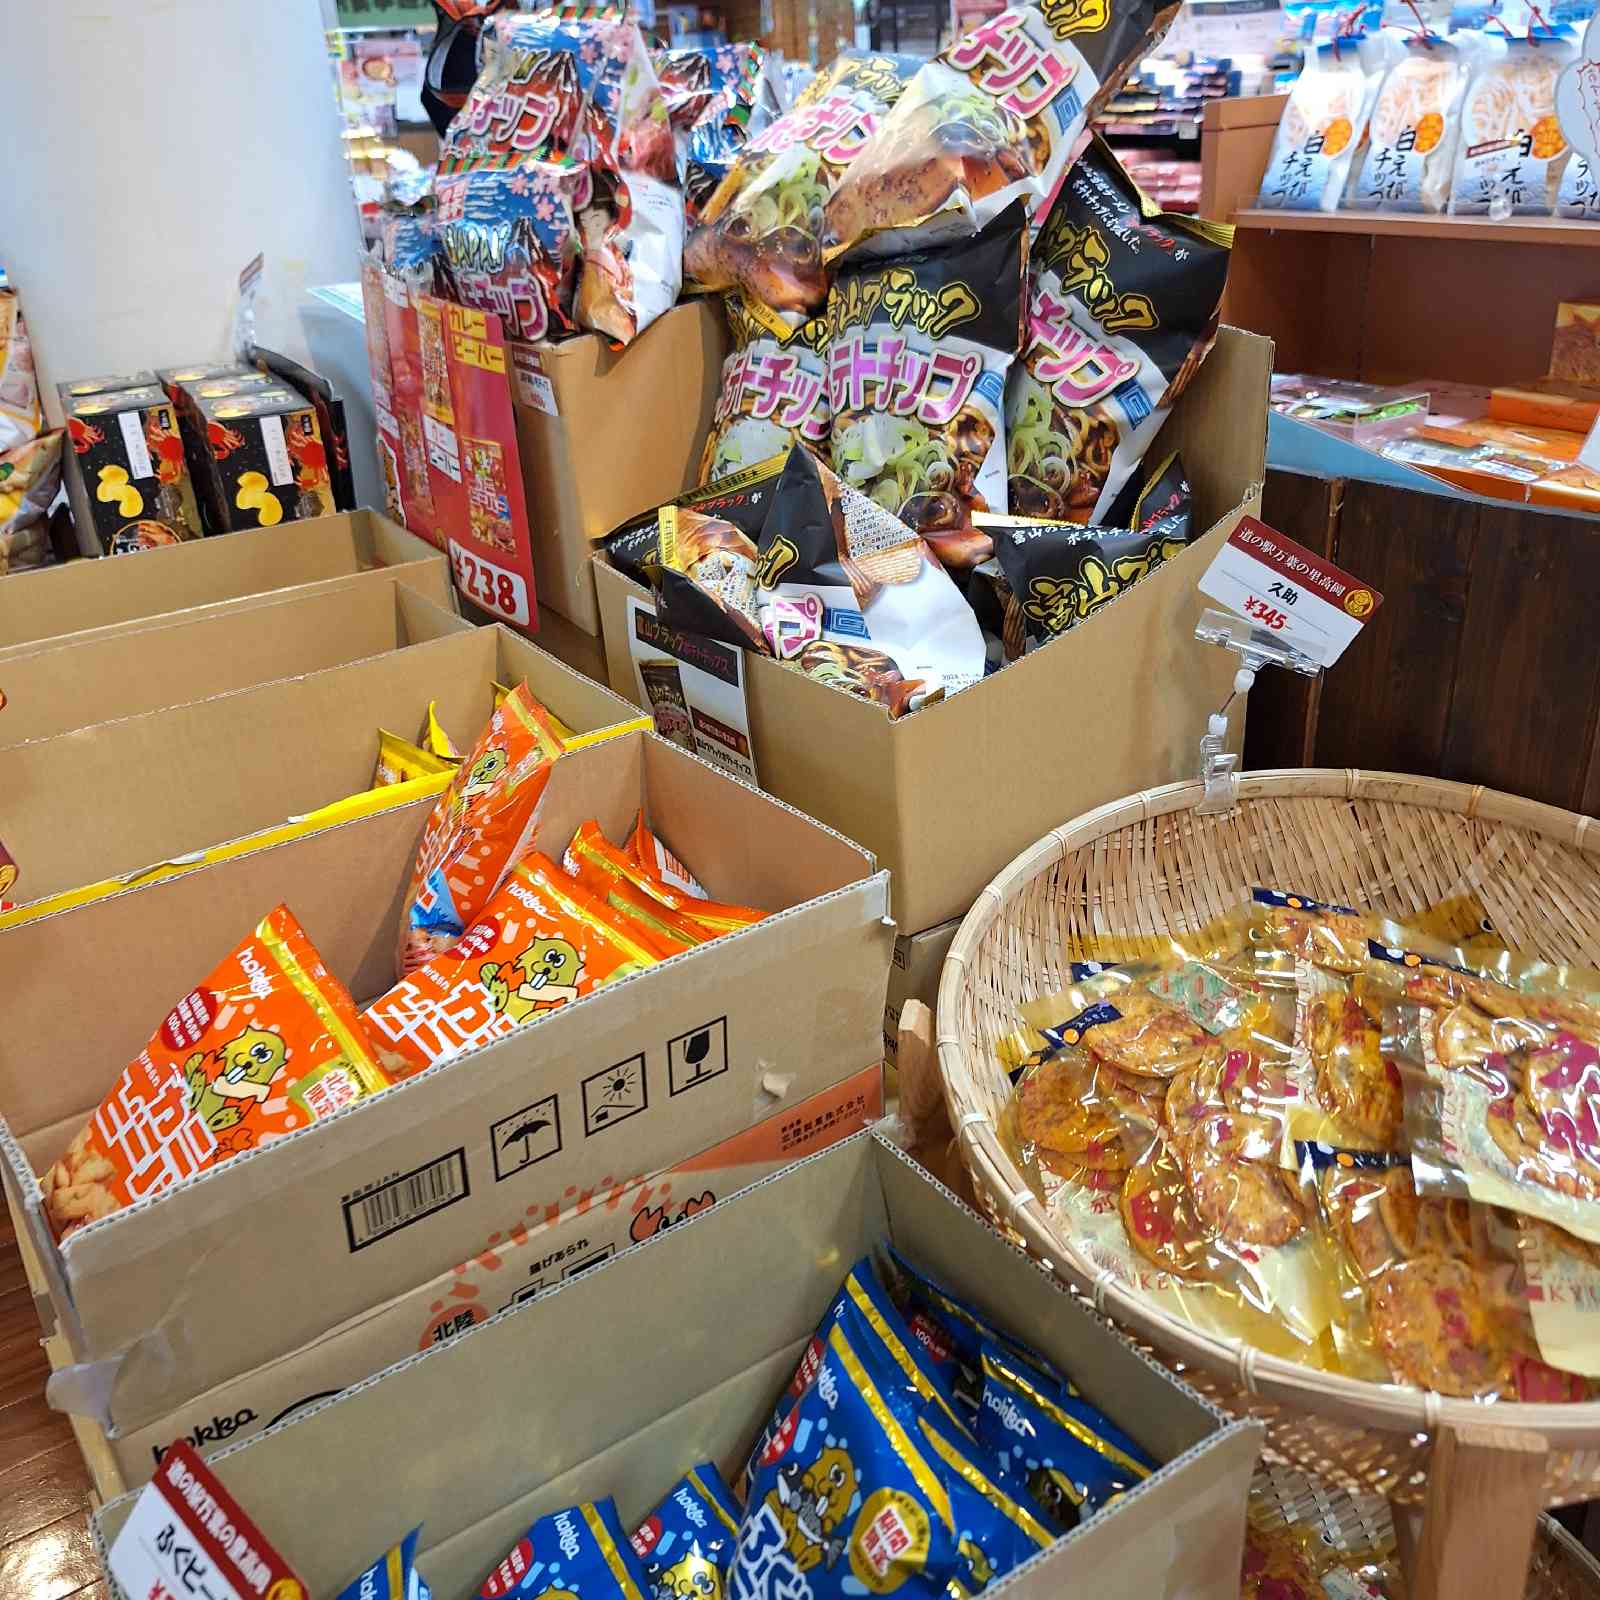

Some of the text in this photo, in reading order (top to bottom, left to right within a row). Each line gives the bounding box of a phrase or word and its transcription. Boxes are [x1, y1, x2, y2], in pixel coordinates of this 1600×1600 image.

[455, 549, 520, 617] ¥238
[1267, 581, 1299, 607] 久助
[672, 1487, 708, 1529] hokka
[552, 1510, 582, 1560] hokka
